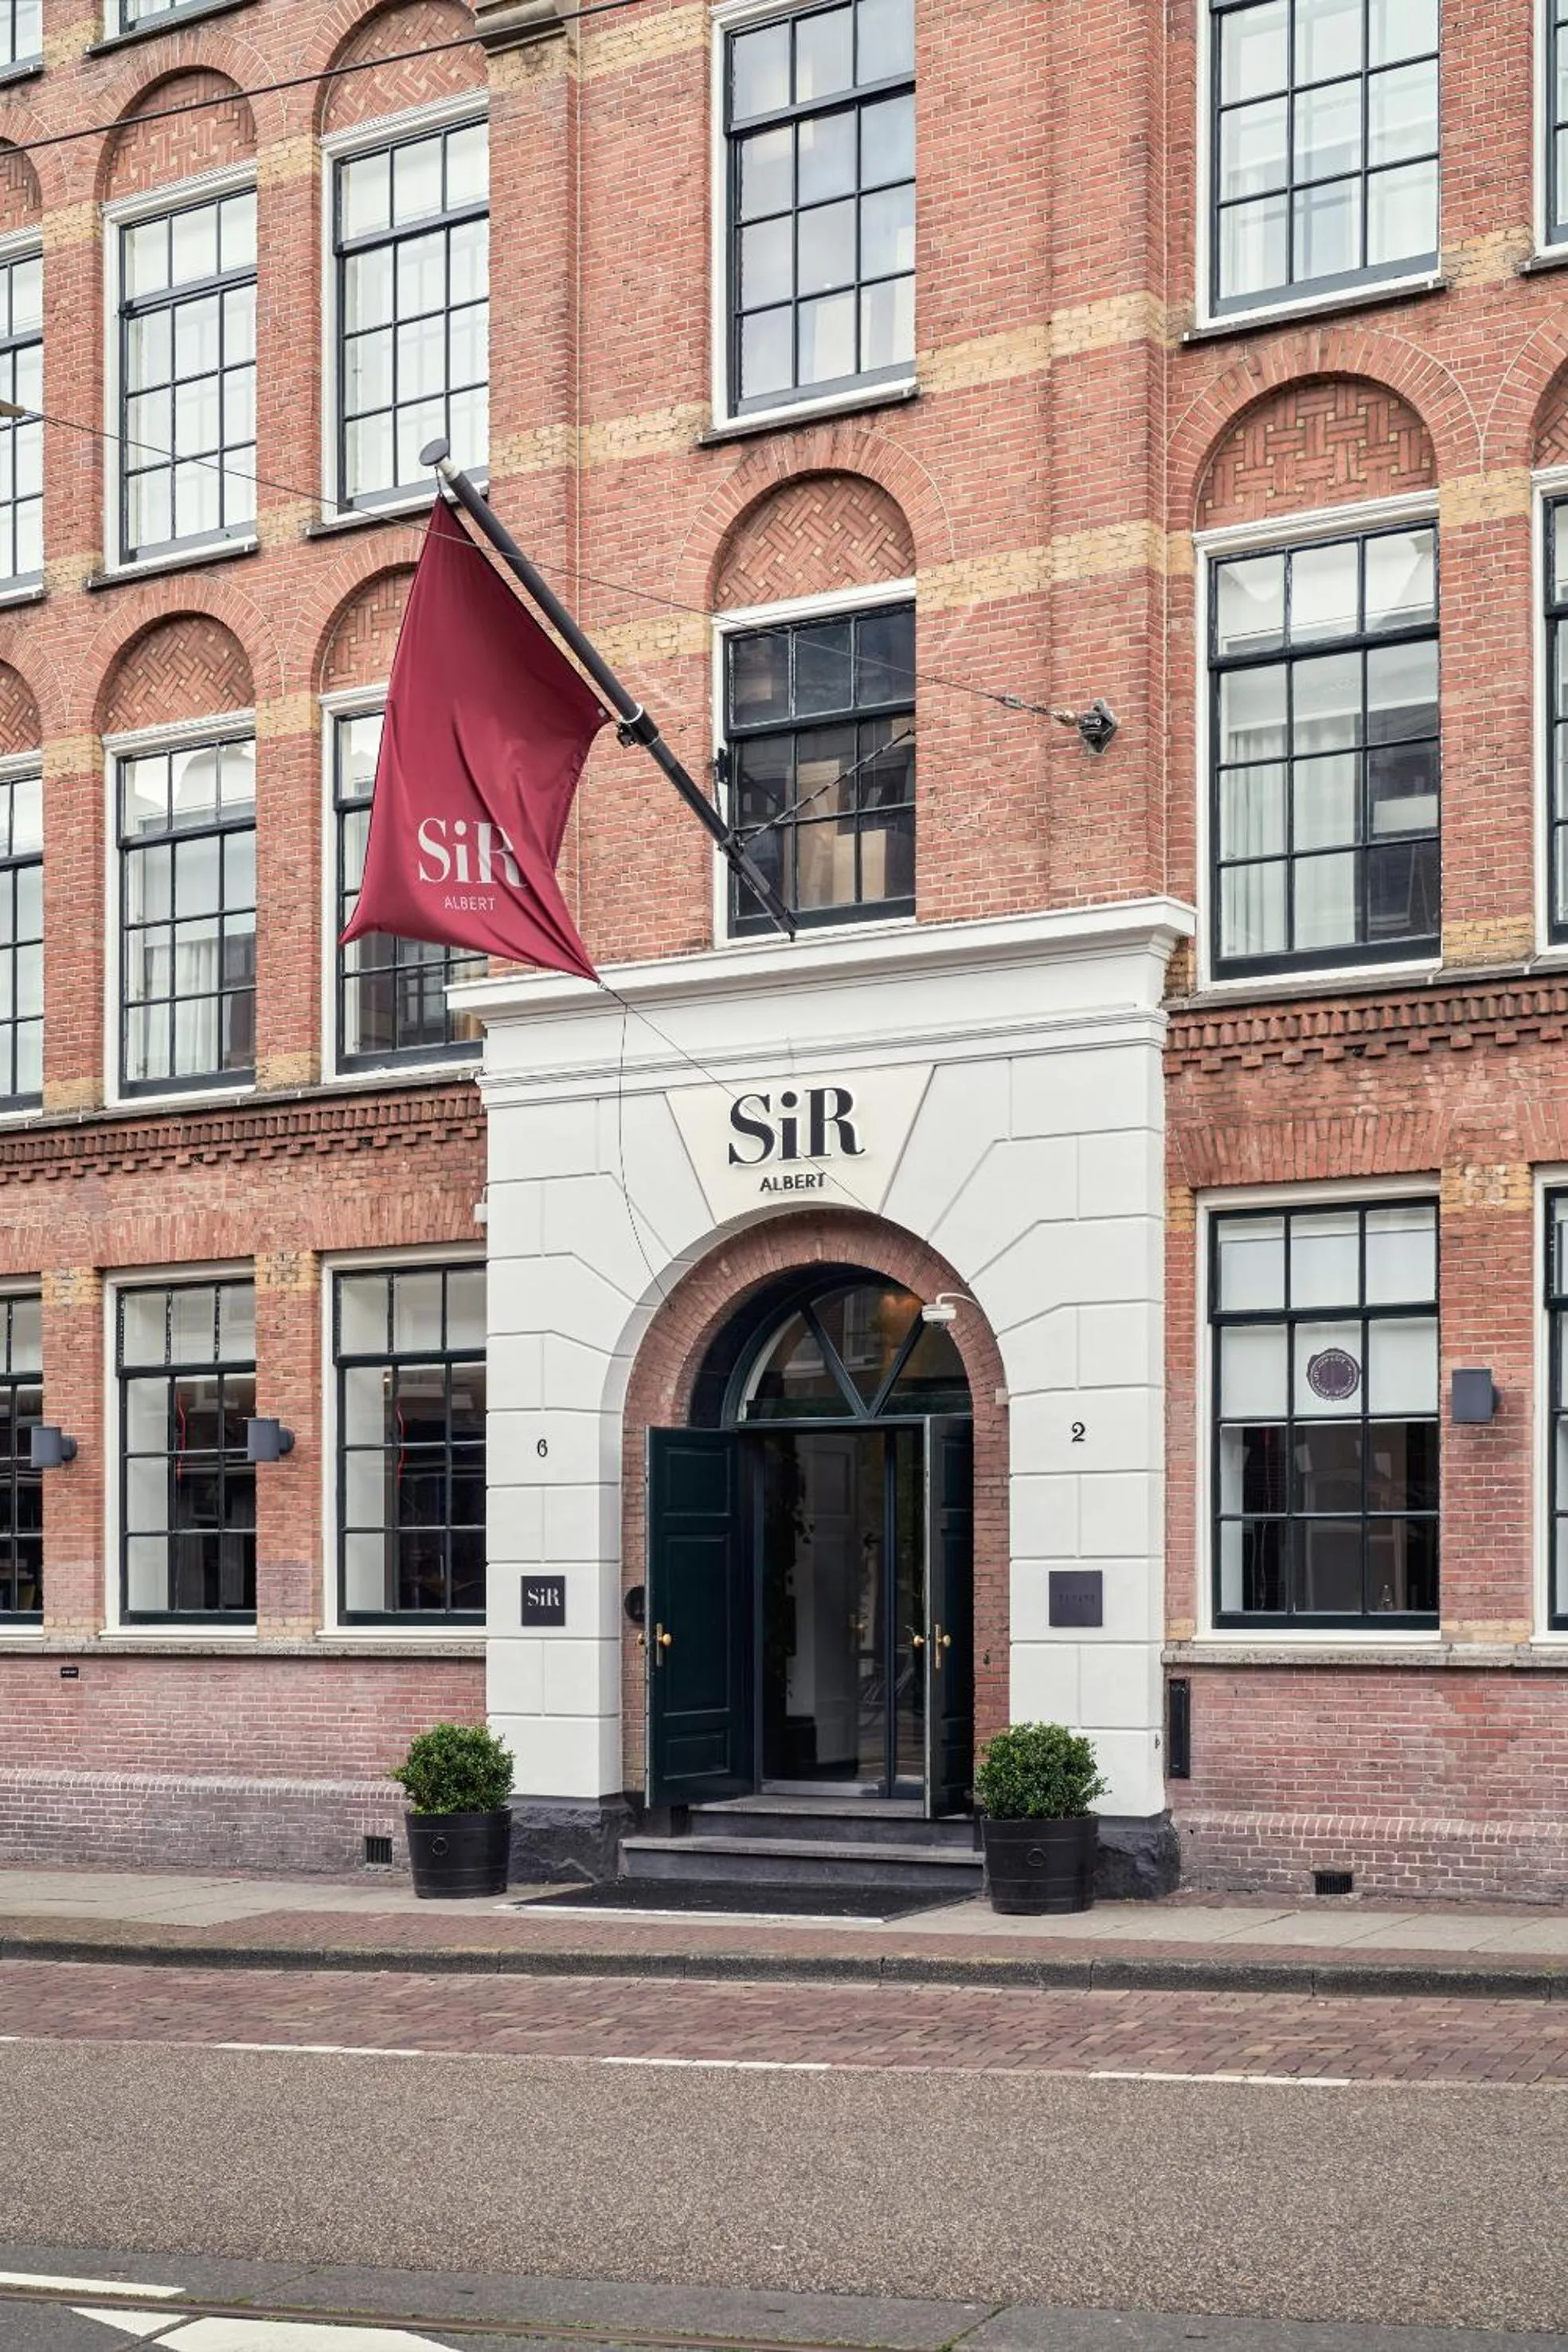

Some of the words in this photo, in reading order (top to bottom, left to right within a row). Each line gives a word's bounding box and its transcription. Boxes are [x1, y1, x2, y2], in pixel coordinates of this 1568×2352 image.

[418, 817, 527, 888] SiR
[444, 895, 496, 910] ALBERT
[729, 1087, 866, 1165] SiR
[760, 1172, 827, 1192] ALBERT
[1071, 1421, 1086, 1443] 2
[537, 1438, 549, 1458] 6
[527, 1587, 561, 1606] SiR
